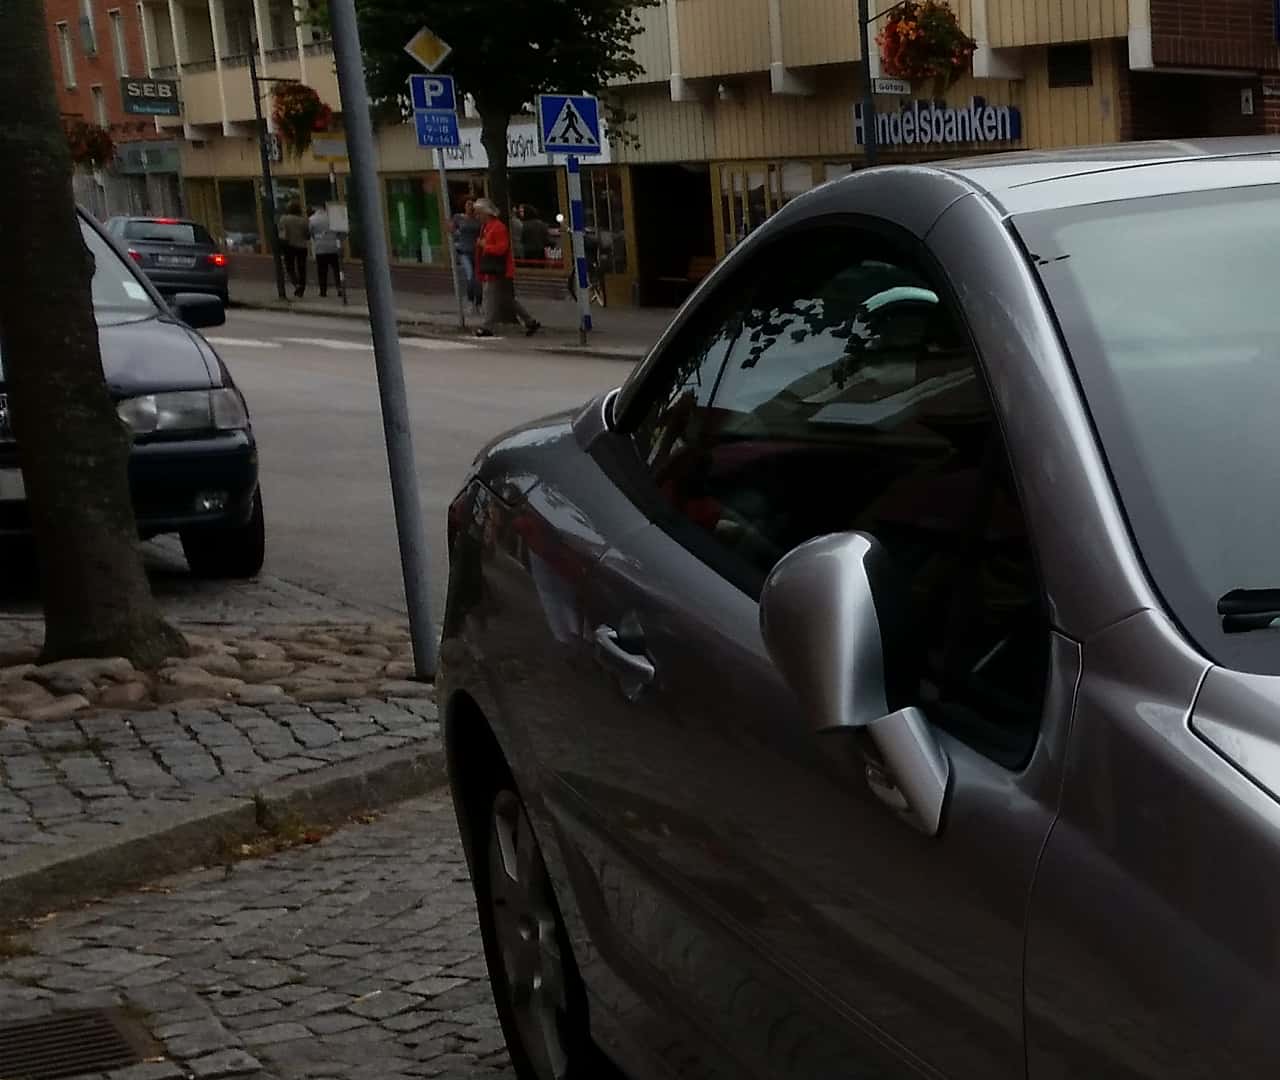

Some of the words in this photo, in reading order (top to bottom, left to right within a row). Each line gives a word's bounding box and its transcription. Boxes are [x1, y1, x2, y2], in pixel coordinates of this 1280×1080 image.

[128, 82, 172, 97] SEB
[424, 79, 444, 107] P
[853, 96, 1012, 145] Hndelsbanken
